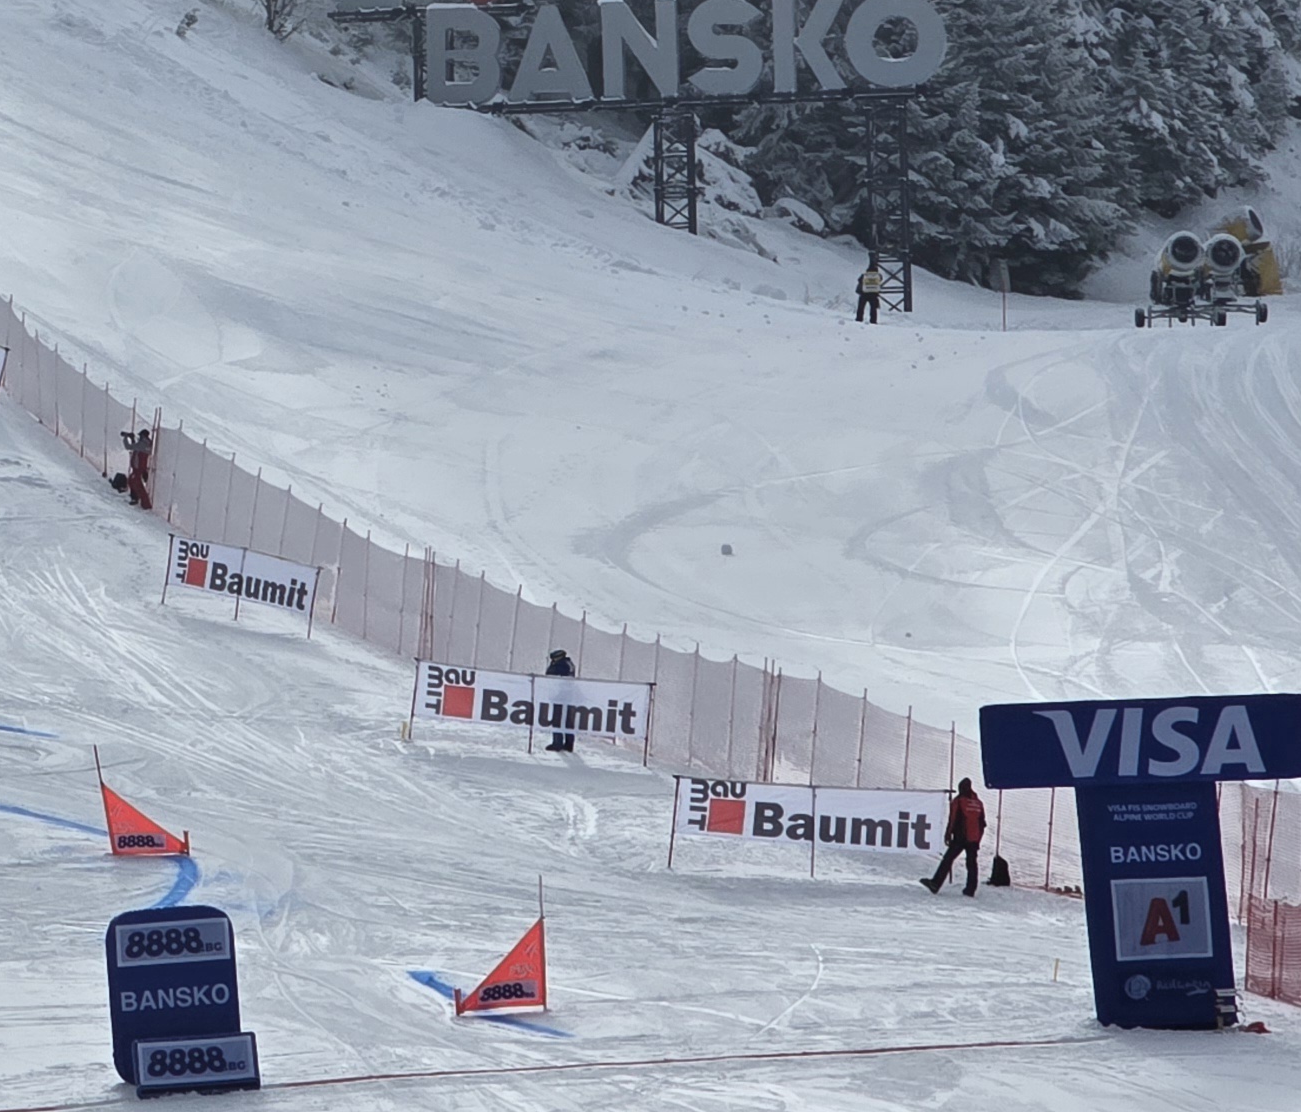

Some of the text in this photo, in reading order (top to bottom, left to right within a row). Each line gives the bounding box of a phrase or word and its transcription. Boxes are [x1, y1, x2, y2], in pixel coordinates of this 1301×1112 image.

[209, 561, 308, 611] Baumit
[480, 688, 637, 735] Baumit
[1032, 705, 1267, 778] VISA
[752, 800, 932, 850] Baumit
[1176, 811, 1195, 820] CUP
[1109, 842, 1203, 864] BANSKO
[1140, 889, 1191, 947] A1
[120, 983, 230, 1012] BANSKO
